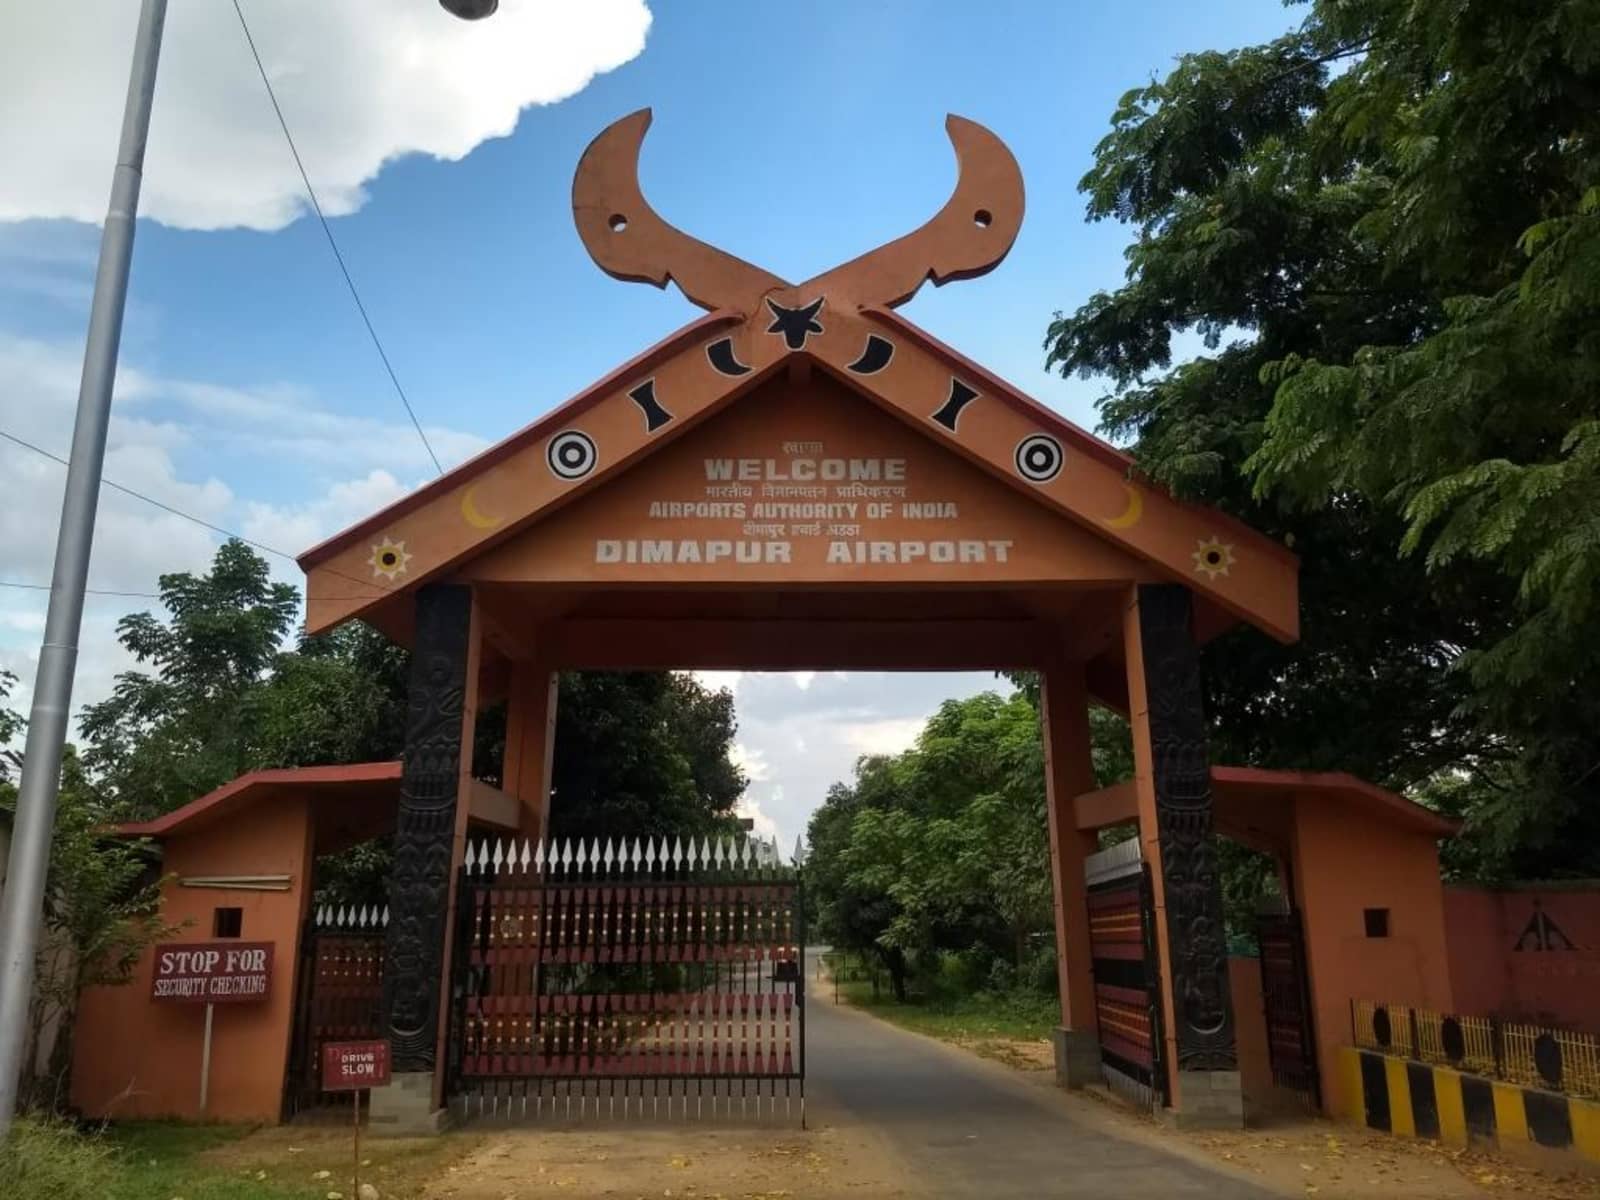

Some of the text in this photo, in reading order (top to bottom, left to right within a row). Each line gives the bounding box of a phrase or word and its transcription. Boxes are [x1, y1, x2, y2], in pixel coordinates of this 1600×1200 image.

[704, 458, 907, 481] WELCOME
[649, 502, 959, 519] AIRPORTS AUTHORITY OF INDIA
[595, 539, 1013, 564] DIMAPUR AIRPORT
[160, 950, 267, 974] STOP FOR
[154, 975, 267, 997] SECURITY CHECKING
[341, 1063, 375, 1075] SLOW
